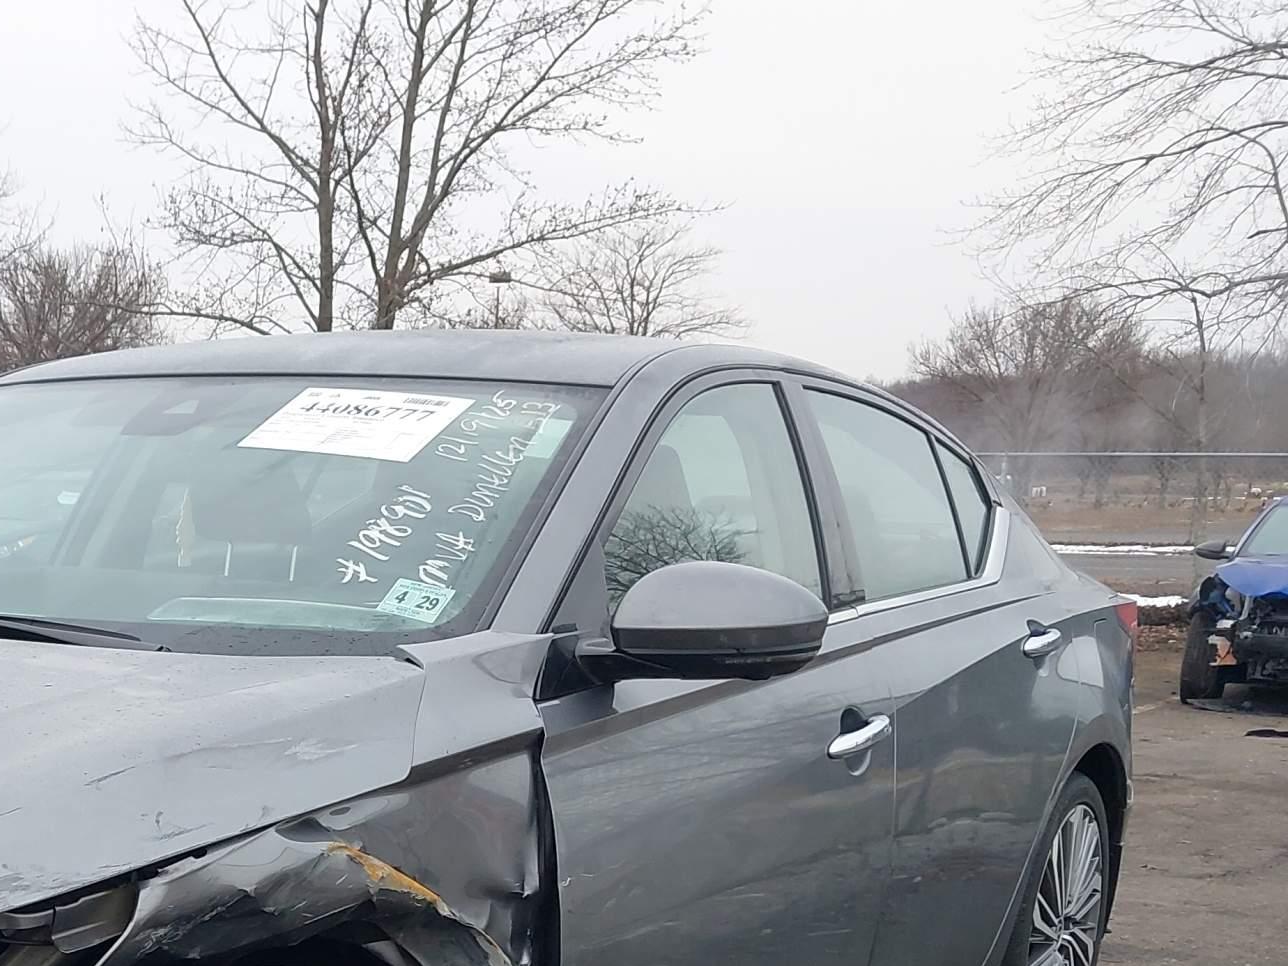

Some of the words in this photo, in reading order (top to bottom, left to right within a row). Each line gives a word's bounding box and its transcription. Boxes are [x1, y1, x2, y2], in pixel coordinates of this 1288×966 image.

[299, 401, 436, 422] 44086777
[395, 590, 409, 604] 4
[414, 595, 440, 611] 29
